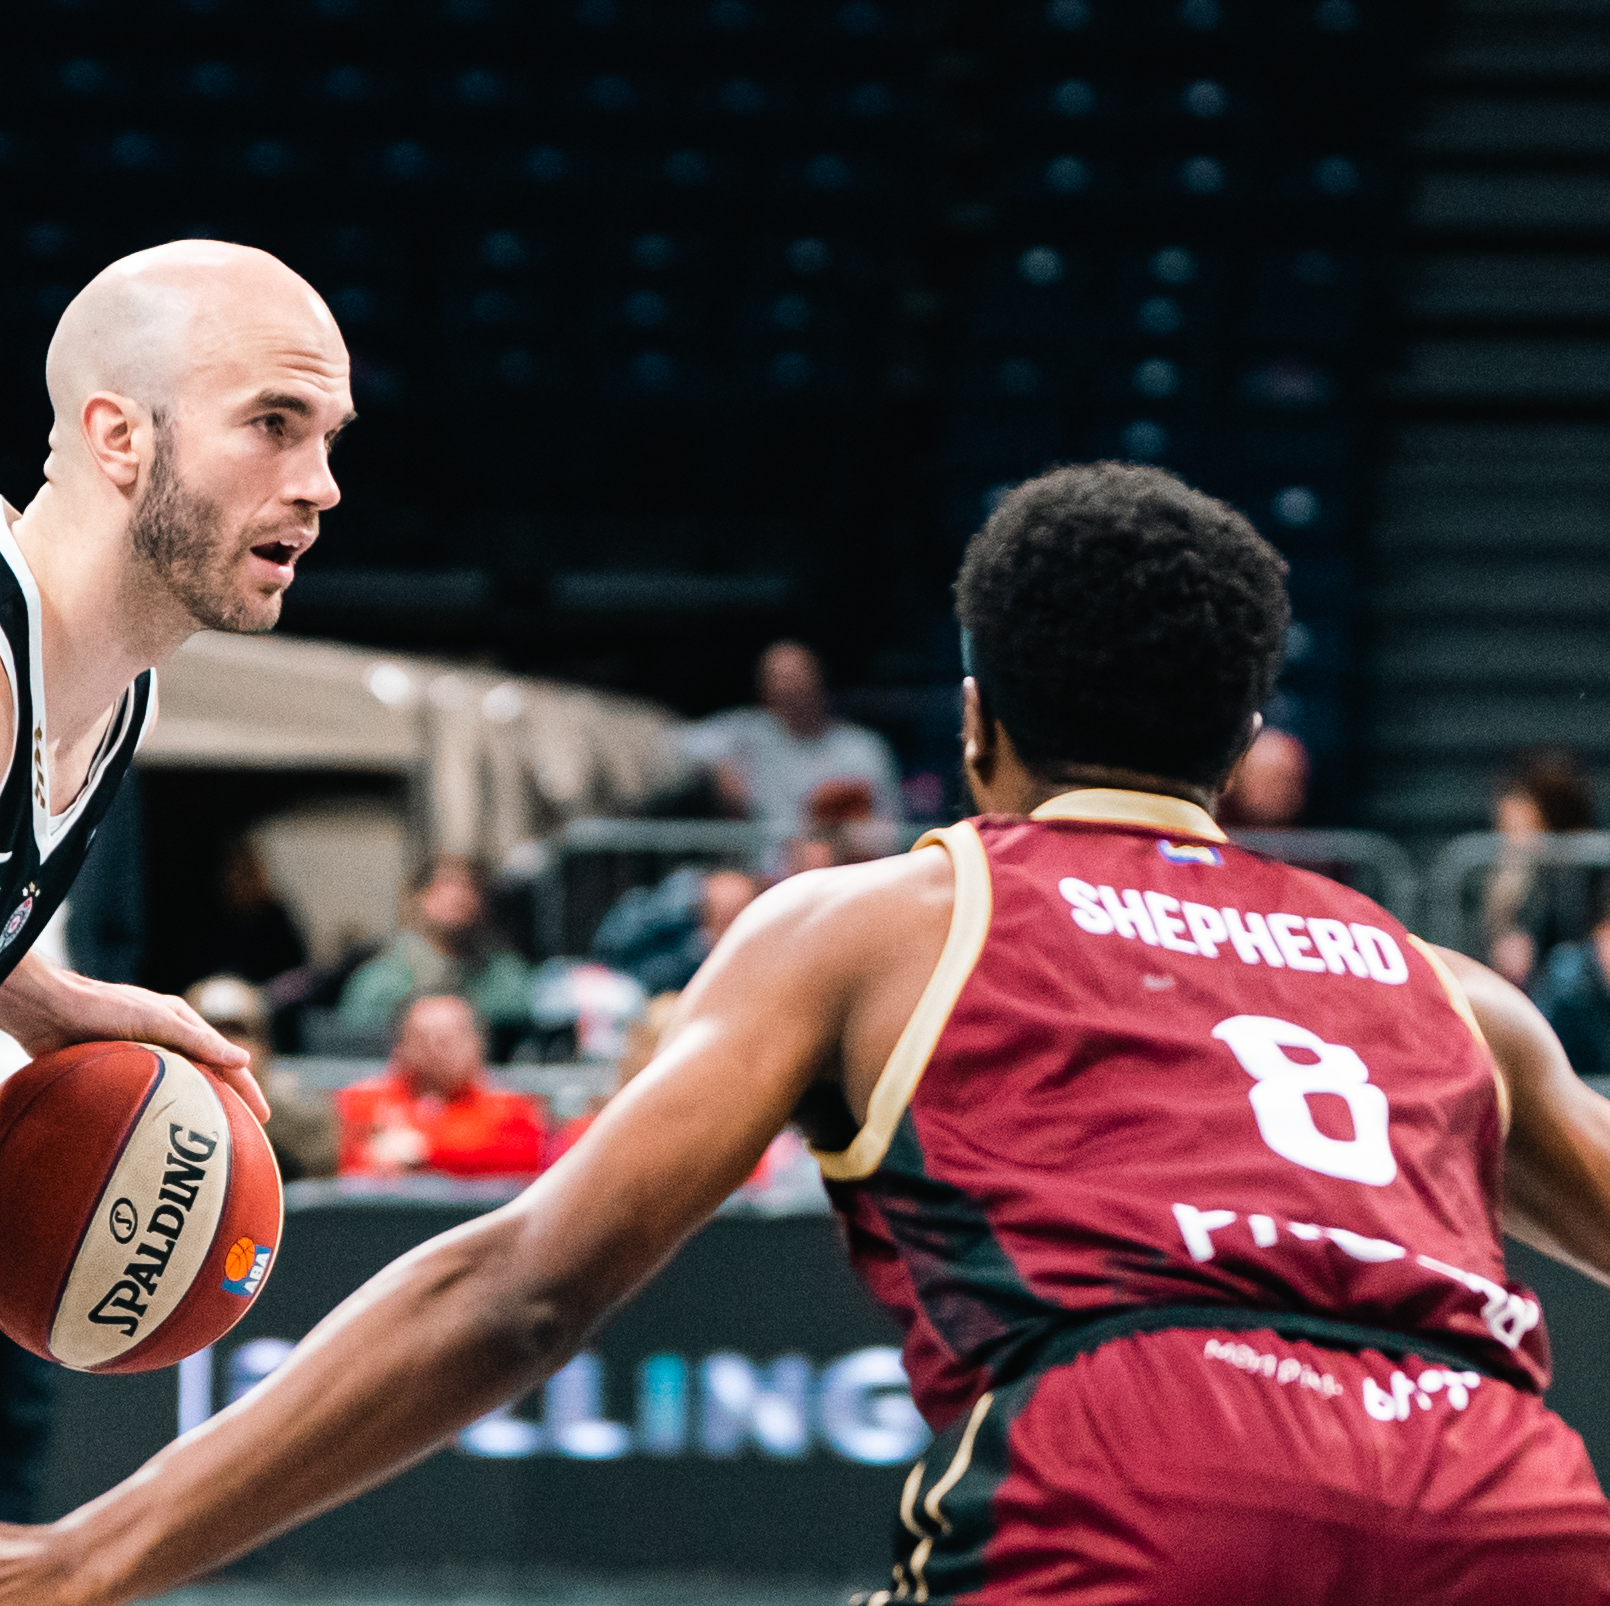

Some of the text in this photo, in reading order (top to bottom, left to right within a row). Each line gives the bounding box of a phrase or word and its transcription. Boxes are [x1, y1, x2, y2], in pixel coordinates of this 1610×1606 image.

[1058, 876, 1409, 985] SHEPHERD
[1211, 1013, 1398, 1187] 8
[87, 1122, 218, 1338] SPALDING
[242, 1251, 271, 1295] ABA
